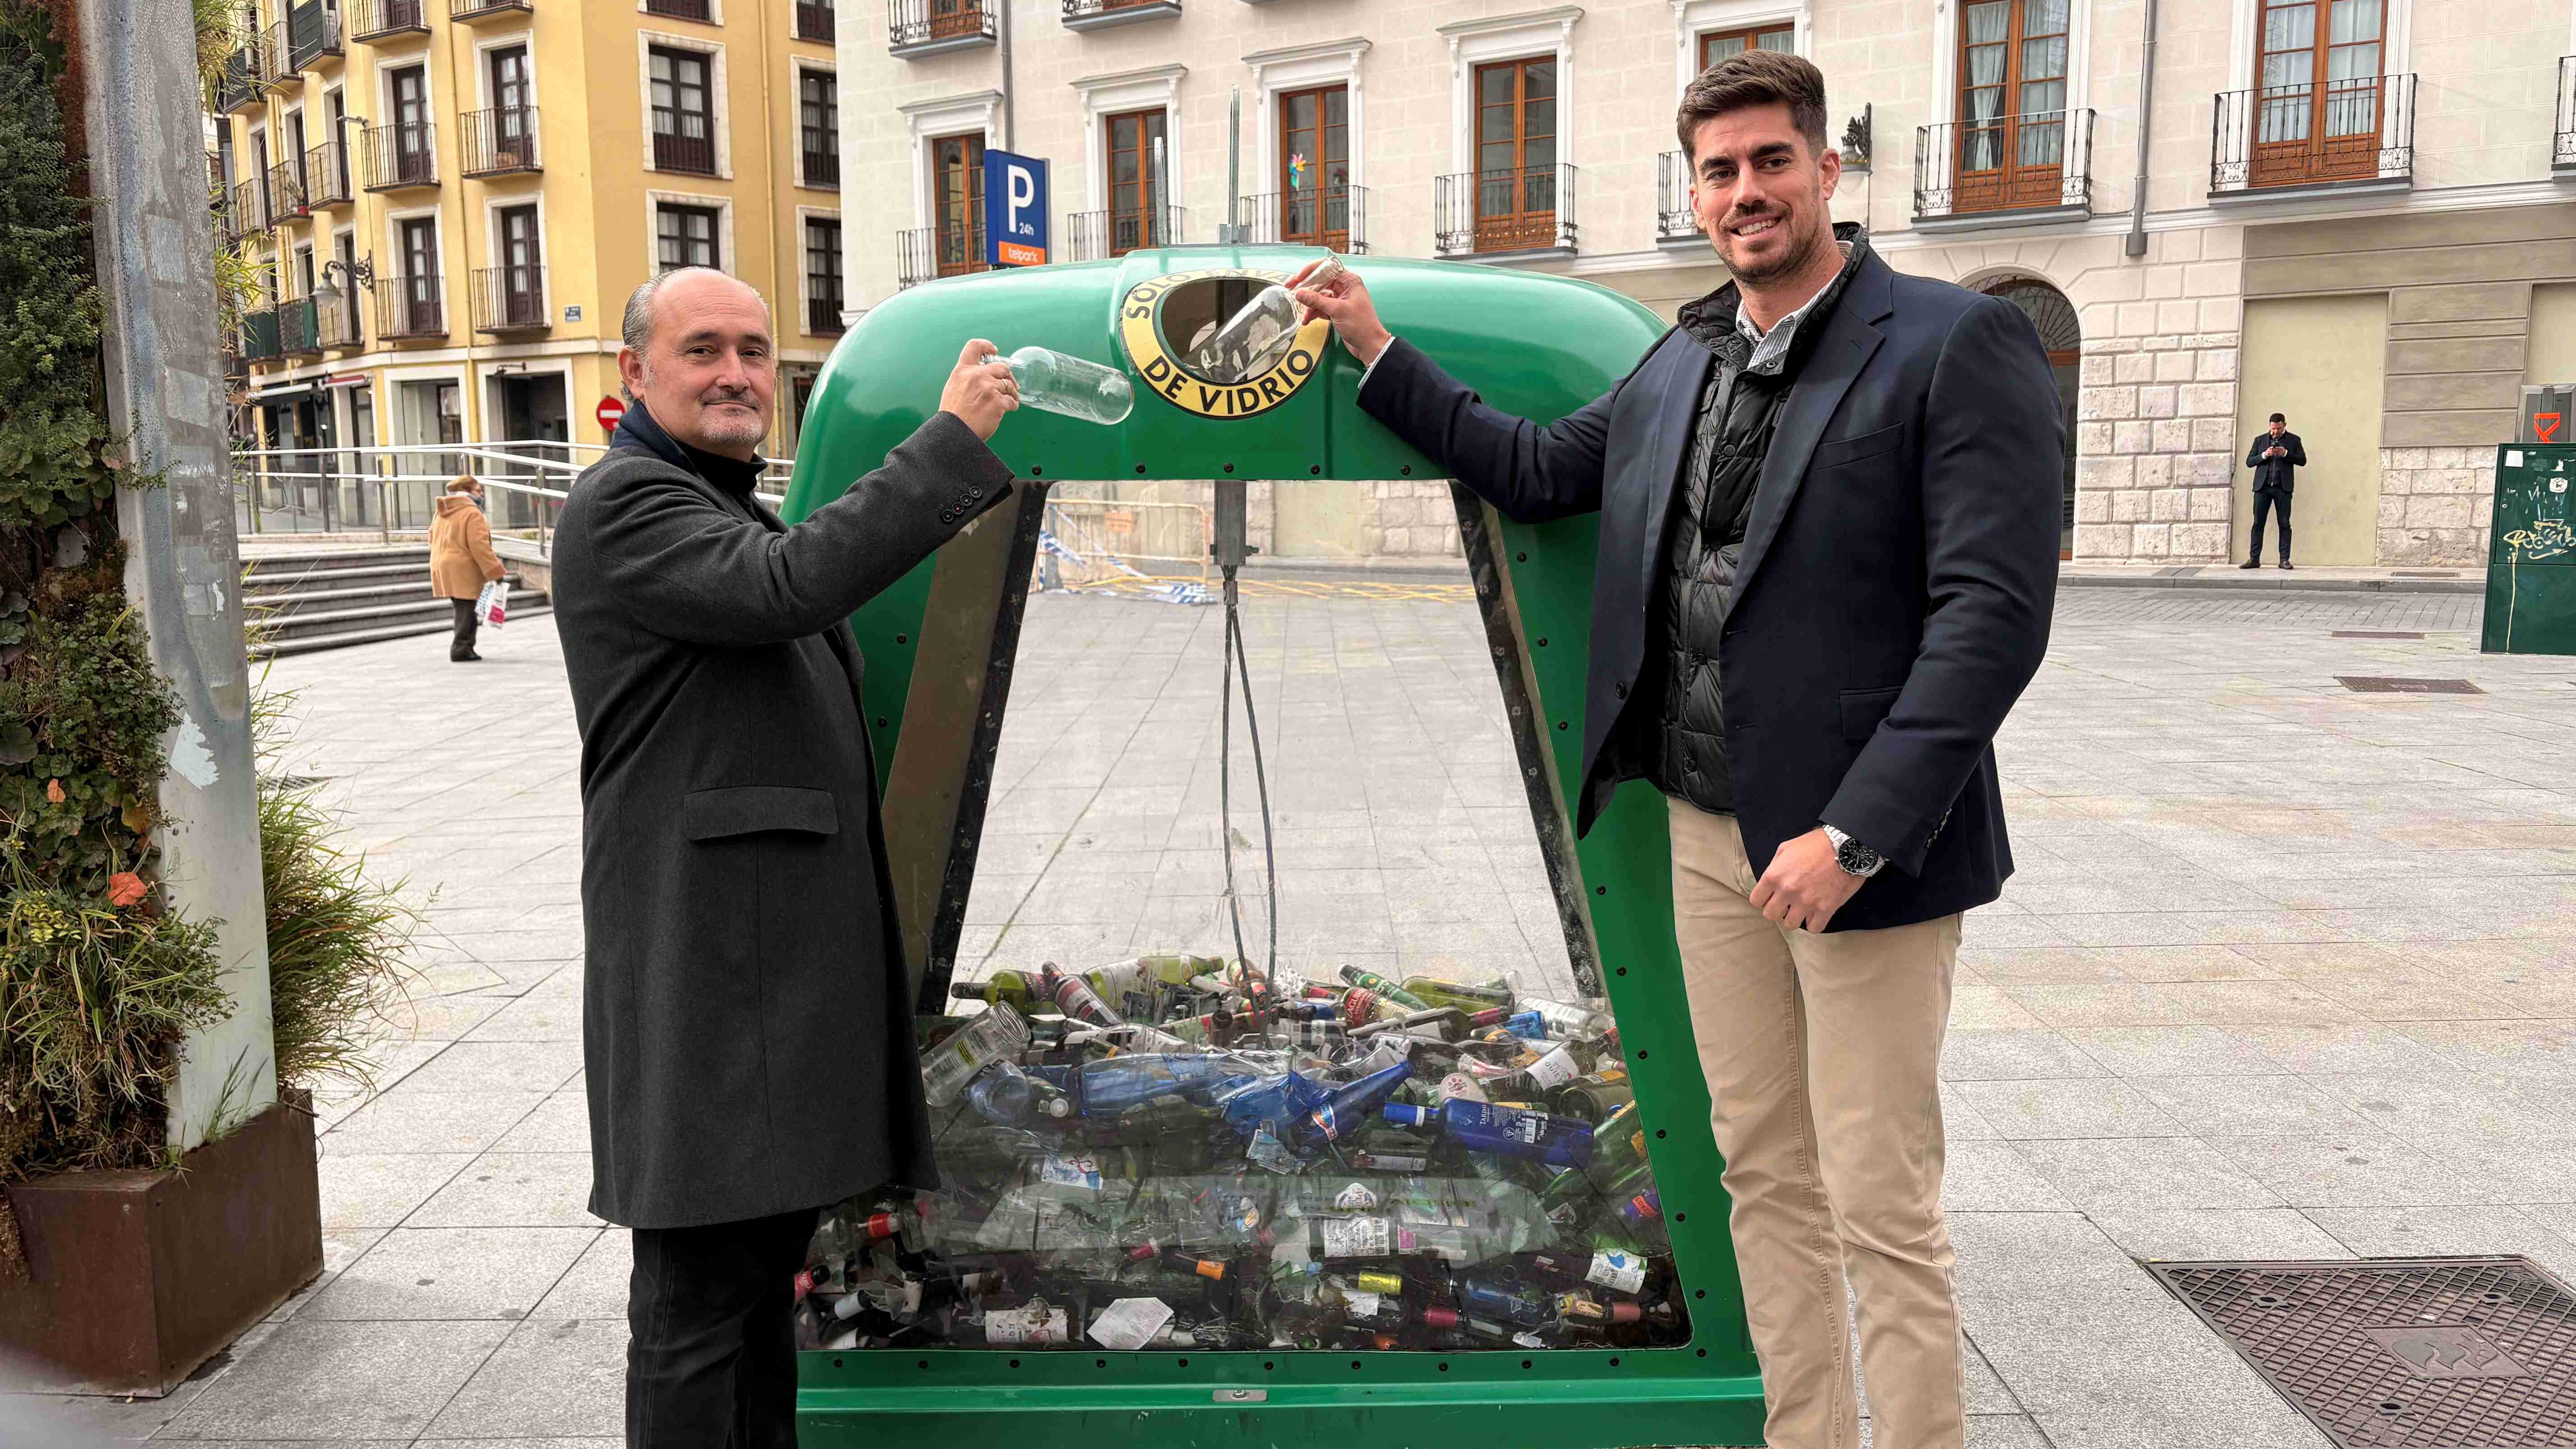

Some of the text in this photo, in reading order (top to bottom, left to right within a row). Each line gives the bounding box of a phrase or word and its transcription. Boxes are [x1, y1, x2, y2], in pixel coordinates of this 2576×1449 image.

[1008, 164, 1034, 233] P
[1019, 222, 1034, 236] 24h
[1008, 247, 1038, 263] telpark
[1126, 270, 1291, 319] SOLO ENVA
[1144, 350, 1313, 414] DE VIDRIO
